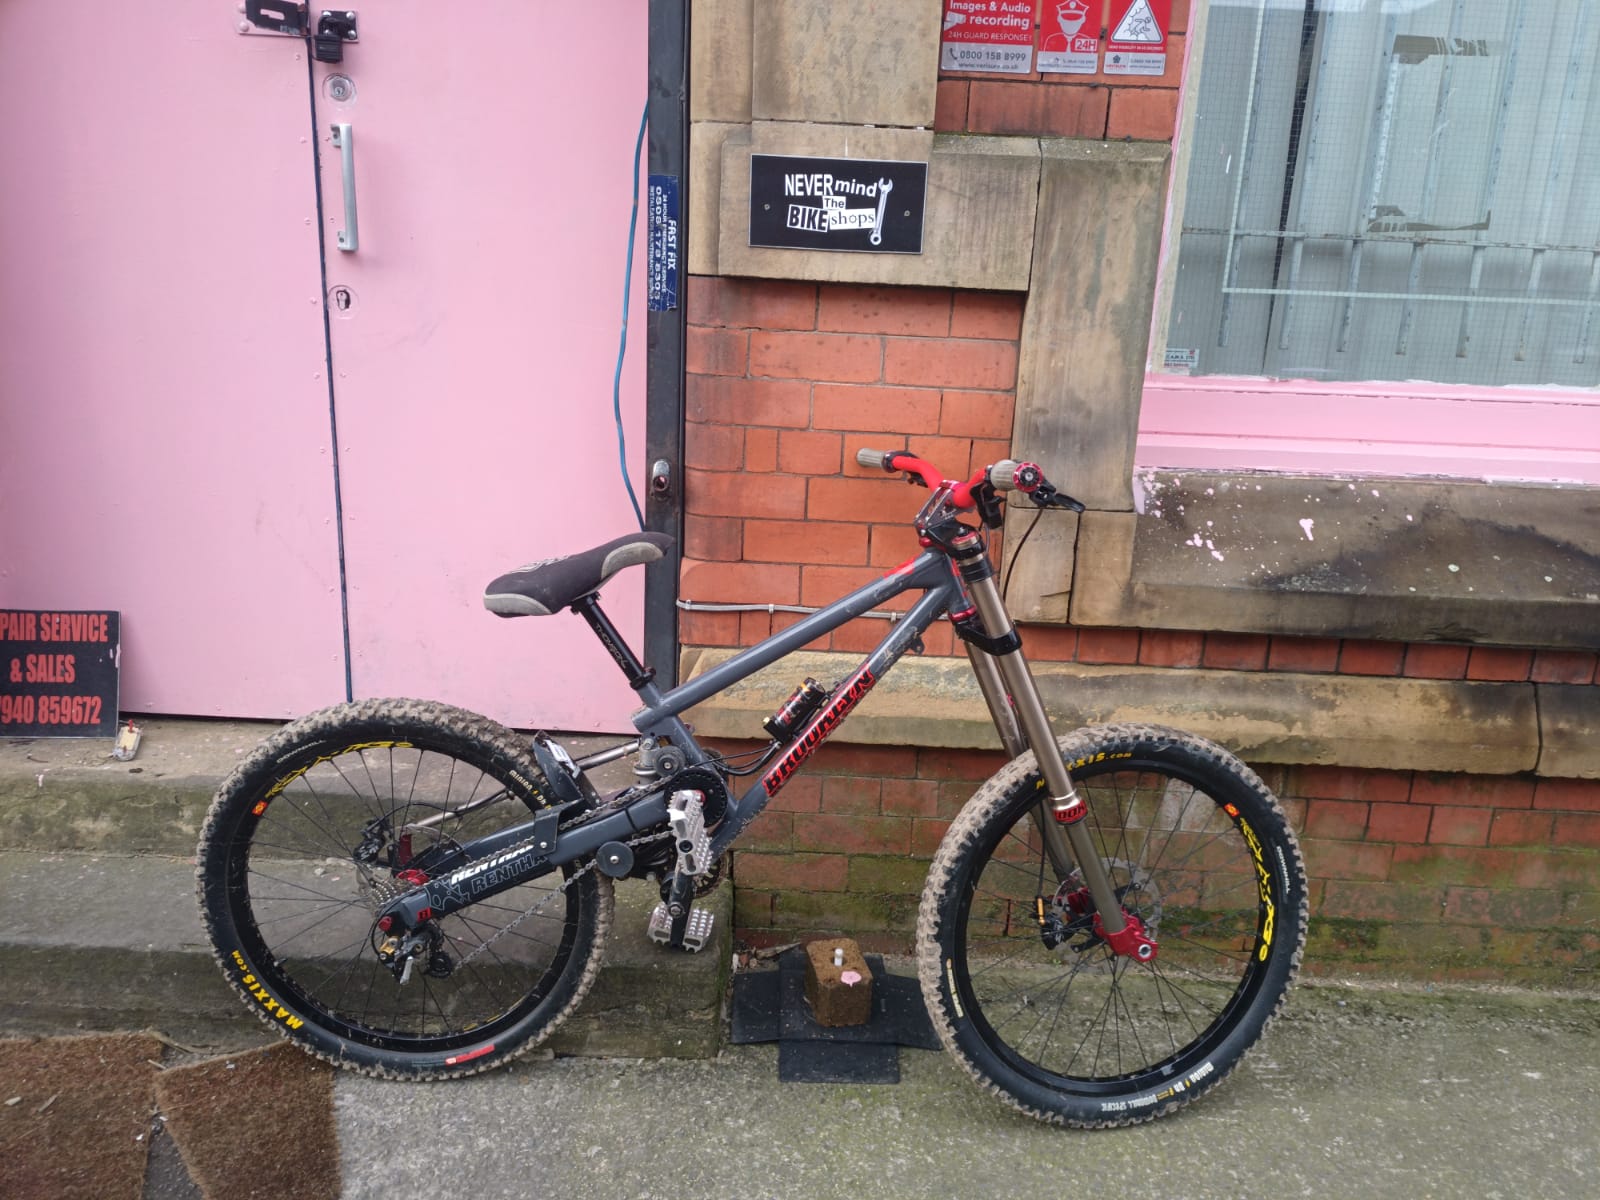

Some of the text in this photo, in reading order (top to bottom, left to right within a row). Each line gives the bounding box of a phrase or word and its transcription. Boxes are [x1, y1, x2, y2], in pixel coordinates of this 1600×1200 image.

[950, 0, 1031, 13] Images & Audio
[969, 14, 1030, 30] recording
[960, 51, 1026, 61] 0800 158 8999
[1076, 39, 1097, 50] 24H
[785, 174, 878, 198] NEVER mind
[824, 197, 845, 209] The
[788, 205, 875, 231] BIKE shops
[667, 219, 678, 270] FAST FIX
[40, 613, 109, 642] SERVICE
[10, 653, 76, 683] & SALES
[0, 695, 102, 725] 940 859672
